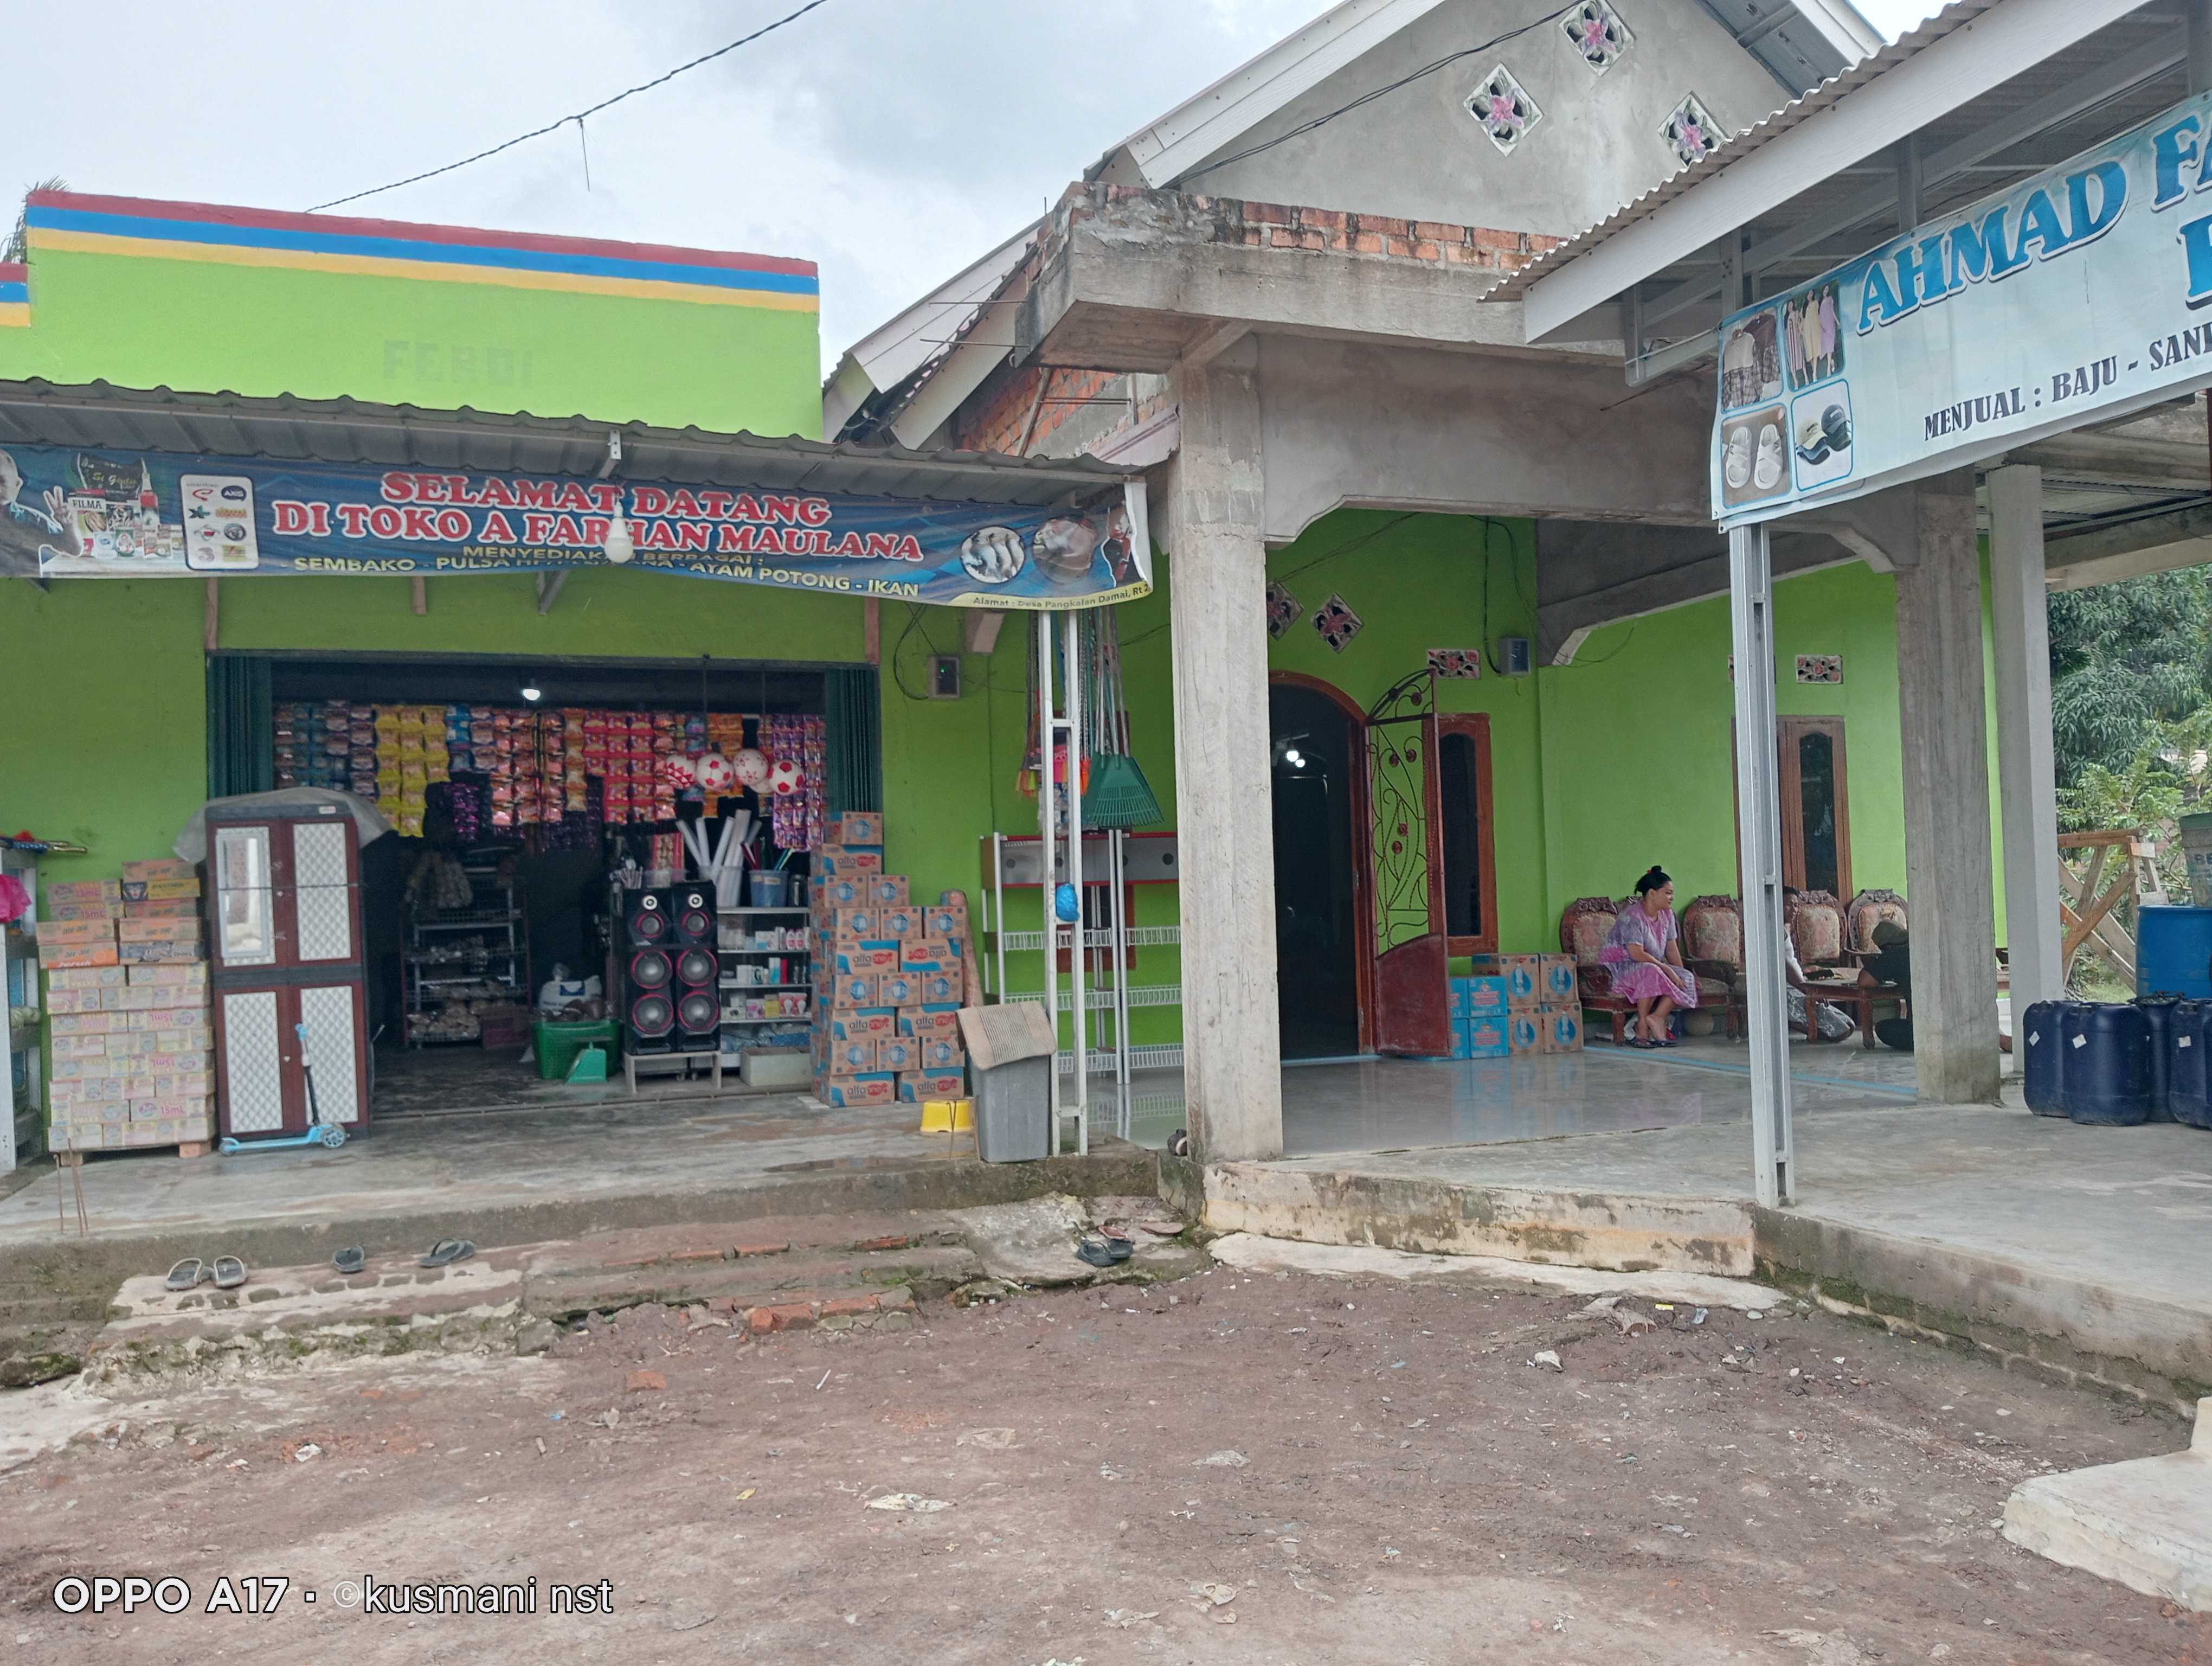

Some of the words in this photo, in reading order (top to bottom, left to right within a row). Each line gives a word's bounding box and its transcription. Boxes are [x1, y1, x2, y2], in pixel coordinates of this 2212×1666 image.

[1856, 157, 2130, 335] AHMAD
[1924, 387, 2026, 442] MENJUAL
[2034, 387, 2041, 408] :
[2052, 355, 2117, 403] BAJU
[2127, 360, 2139, 371] -
[73, 499, 102, 510] FILMA
[381, 471, 625, 515] SELAMAT
[632, 487, 832, 527] DATANG
[273, 500, 331, 538] DI
[336, 503, 472, 541] TOKO
[477, 510, 519, 544] A
[717, 523, 924, 563] MAULANA
[294, 557, 416, 572] SEMBAKO
[436, 558, 510, 570] PULSA
[689, 562, 753, 579] AYAM
[759, 566, 850, 591] POTONG
[867, 579, 920, 596] IKAN
[973, 597, 1009, 606] Alamat
[1045, 598, 1096, 609] Pangkalan
[1098, 589, 1131, 604] Damai,
[1133, 587, 1143, 595] Rt
[849, 1020, 868, 1029] alfa
[916, 1015, 934, 1026] alfa
[847, 1086, 866, 1095] alfa
[918, 1082, 936, 1091] alfa
